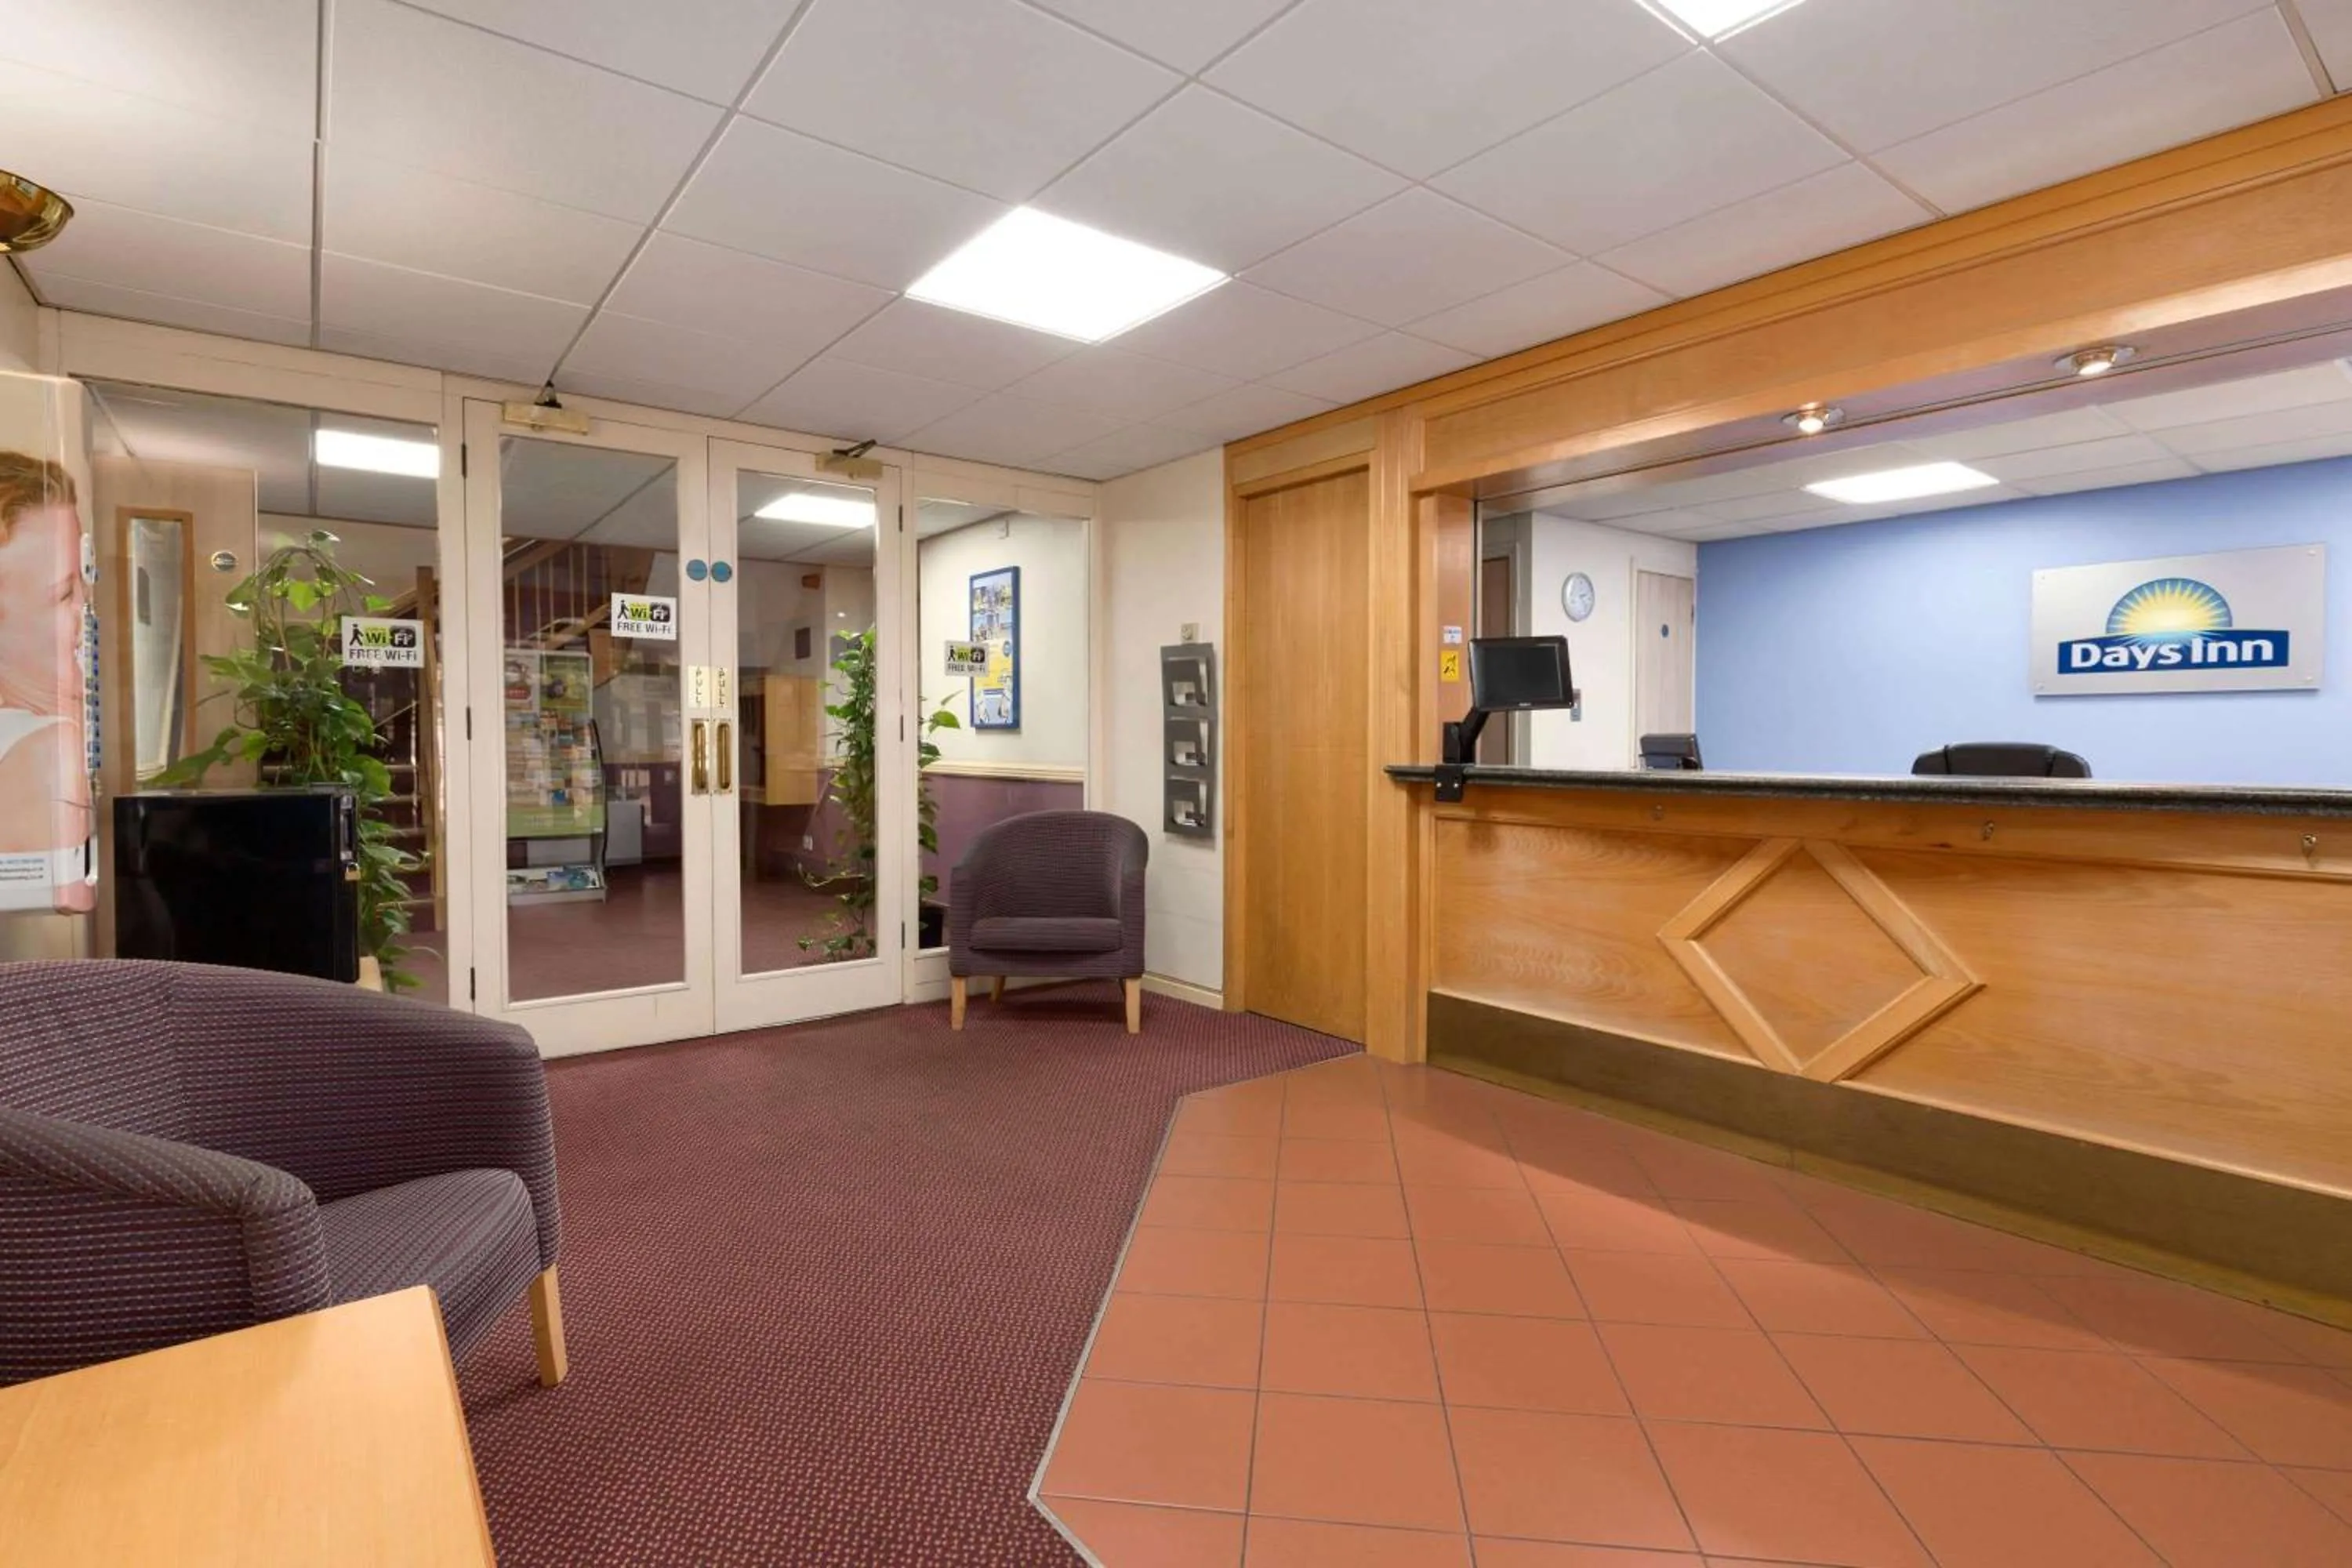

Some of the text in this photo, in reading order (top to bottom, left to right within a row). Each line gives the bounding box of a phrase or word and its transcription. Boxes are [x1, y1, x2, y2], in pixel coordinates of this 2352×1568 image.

[617, 621, 670, 634] FREE Wi-Fi
[350, 648, 417, 661] FREE Wi-Fi
[2071, 637, 2273, 670] Days Inn
